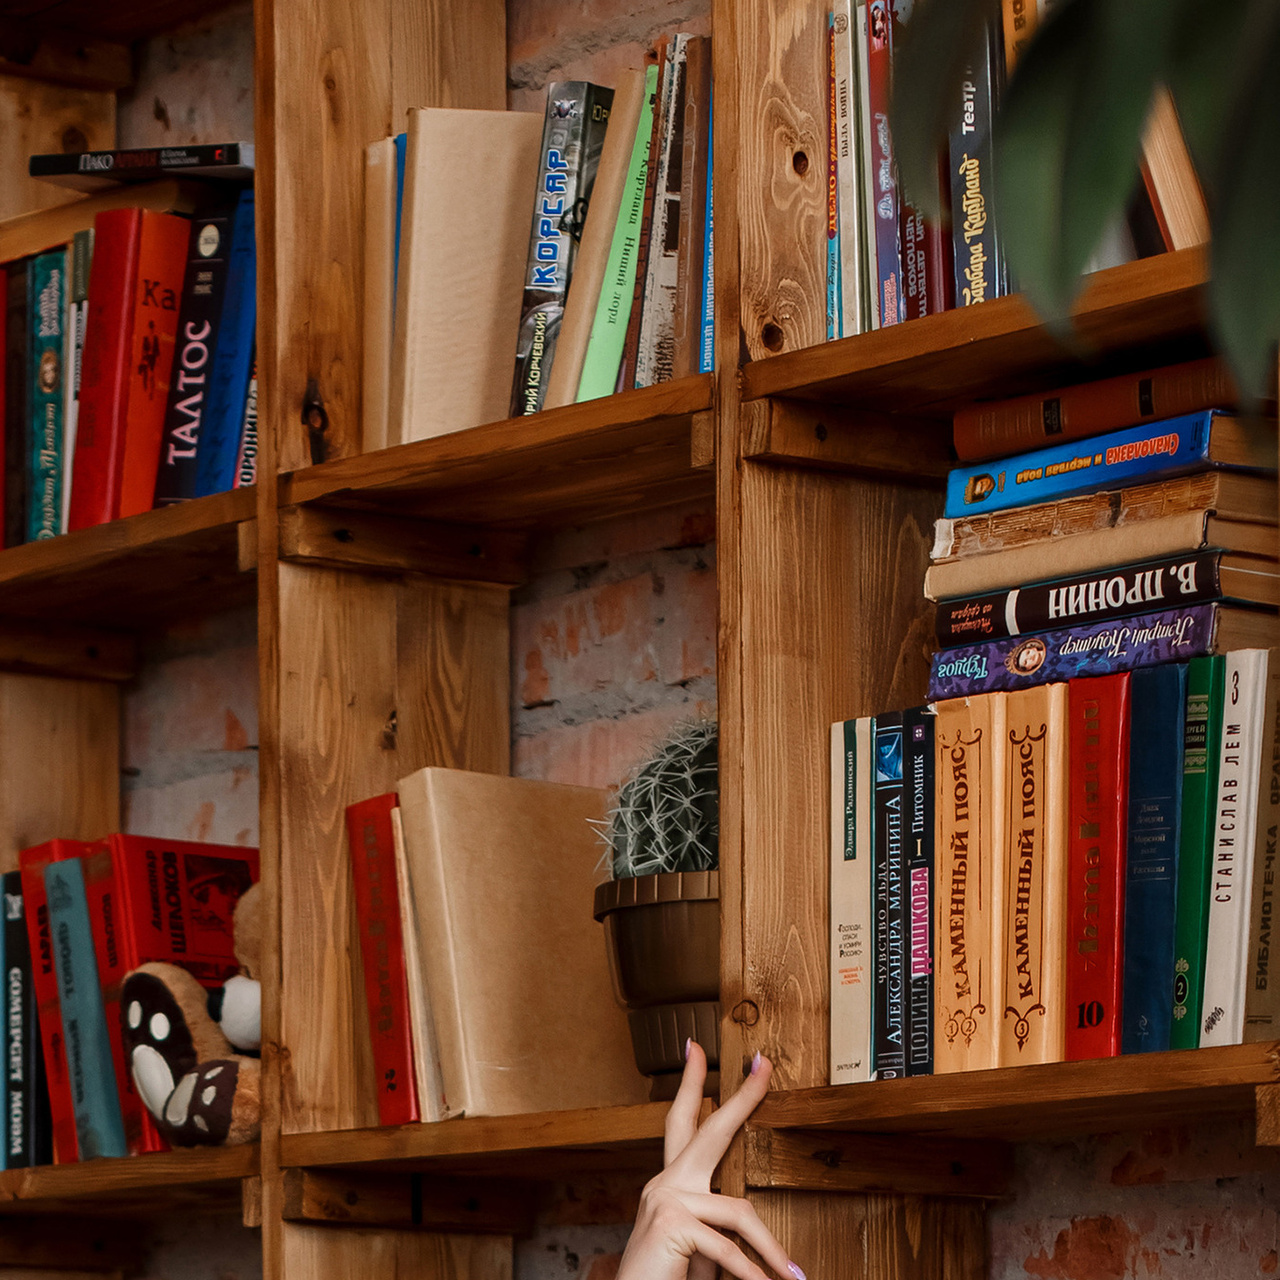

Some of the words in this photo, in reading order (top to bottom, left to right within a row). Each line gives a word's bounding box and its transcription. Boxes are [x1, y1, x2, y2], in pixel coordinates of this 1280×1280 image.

[841, 120, 849, 158] БЫЛА
[962, 80, 977, 136] Театр
[532, 149, 570, 286] КОРСАР
[829, 175, 837, 231] ДЕЛО
[959, 153, 987, 245] Картланд
[616, 236, 635, 287] Нищий
[607, 292, 622, 325] лорд
[167, 319, 211, 466] ТАЛТОС
[1016, 467, 1043, 485] вода
[1106, 432, 1180, 467] Скалолазка
[1048, 567, 1165, 620] ПРОНИН
[1170, 562, 1198, 593] В.
[1060, 627, 1131, 658] Коултер
[1132, 615, 1195, 649] Кэтрин
[938, 654, 988, 681] Герцог
[1224, 723, 1241, 766] ЛЕМ
[844, 750, 856, 815] Радзинский
[950, 746, 971, 821] ПОЯС
[1016, 742, 1036, 818] ПОЯС
[844, 817, 855, 857] Эдвард
[887, 795, 902, 909] МАРИНИНА
[1215, 779, 1238, 903] СТАНИСЛАВ
[878, 860, 888, 903] ЛЬДА
[1015, 828, 1036, 1000] КАМЕННЫЙ
[1254, 824, 1279, 991] БИБЛИОТЕЧКА
[878, 909, 888, 984] ЧУВСТВО
[910, 867, 932, 977] ДАШКОВА
[949, 830, 972, 999] КАМЕННЫЙ
[886, 919, 902, 1045] АЛЕКСАНДРА
[1076, 1000, 1105, 1029] 10
[8, 967, 22, 1082] СОМЕРСЕТ
[910, 976, 930, 1065] ПОЛИНА
[10, 1090, 22, 1155] МОЭМ
